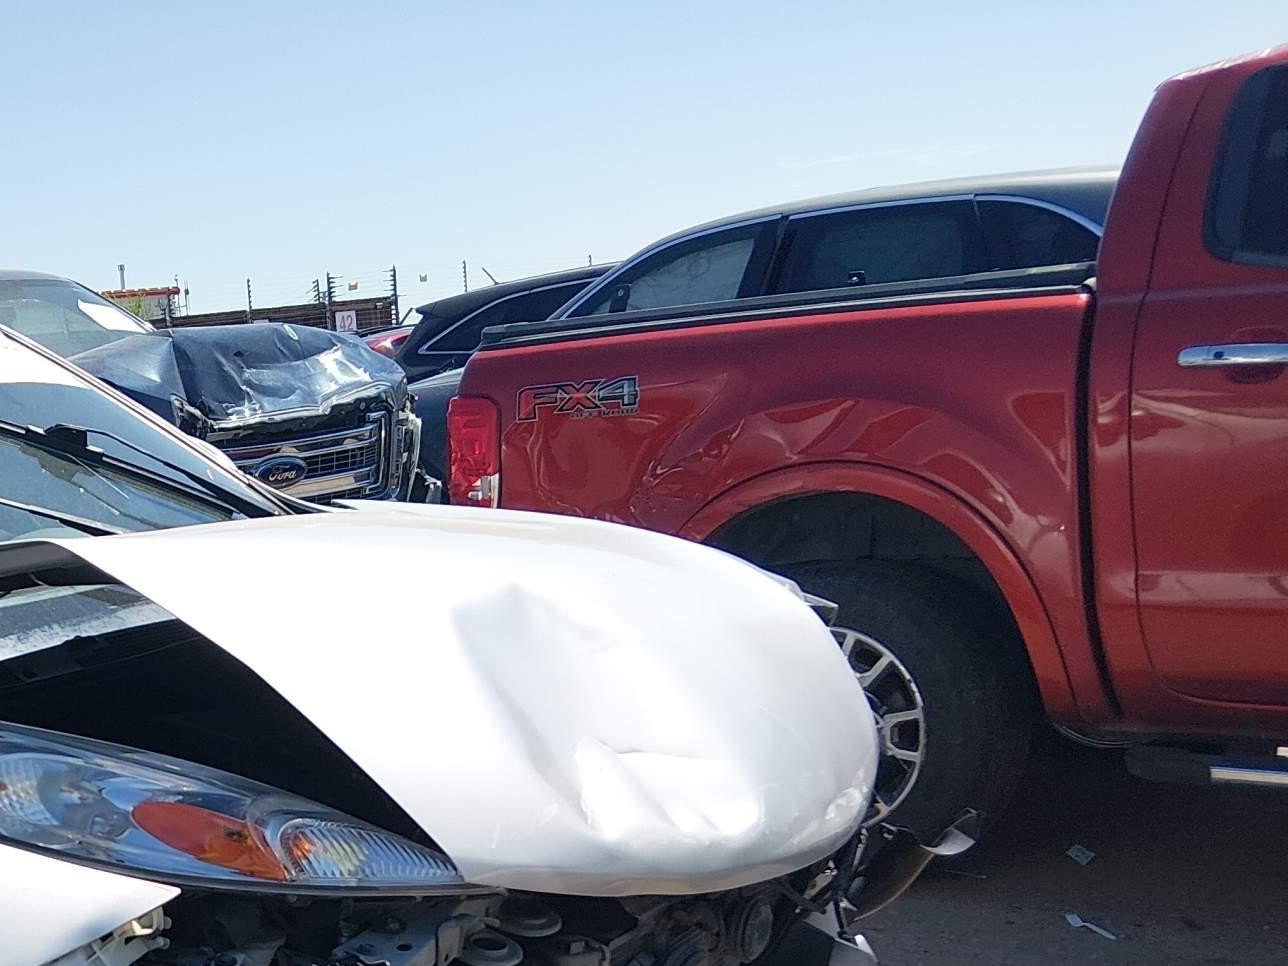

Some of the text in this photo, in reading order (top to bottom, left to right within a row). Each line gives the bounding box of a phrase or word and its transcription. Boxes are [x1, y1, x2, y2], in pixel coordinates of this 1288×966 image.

[339, 314, 354, 331] 42
[516, 376, 640, 422] FX4
[268, 464, 296, 481] Ford
